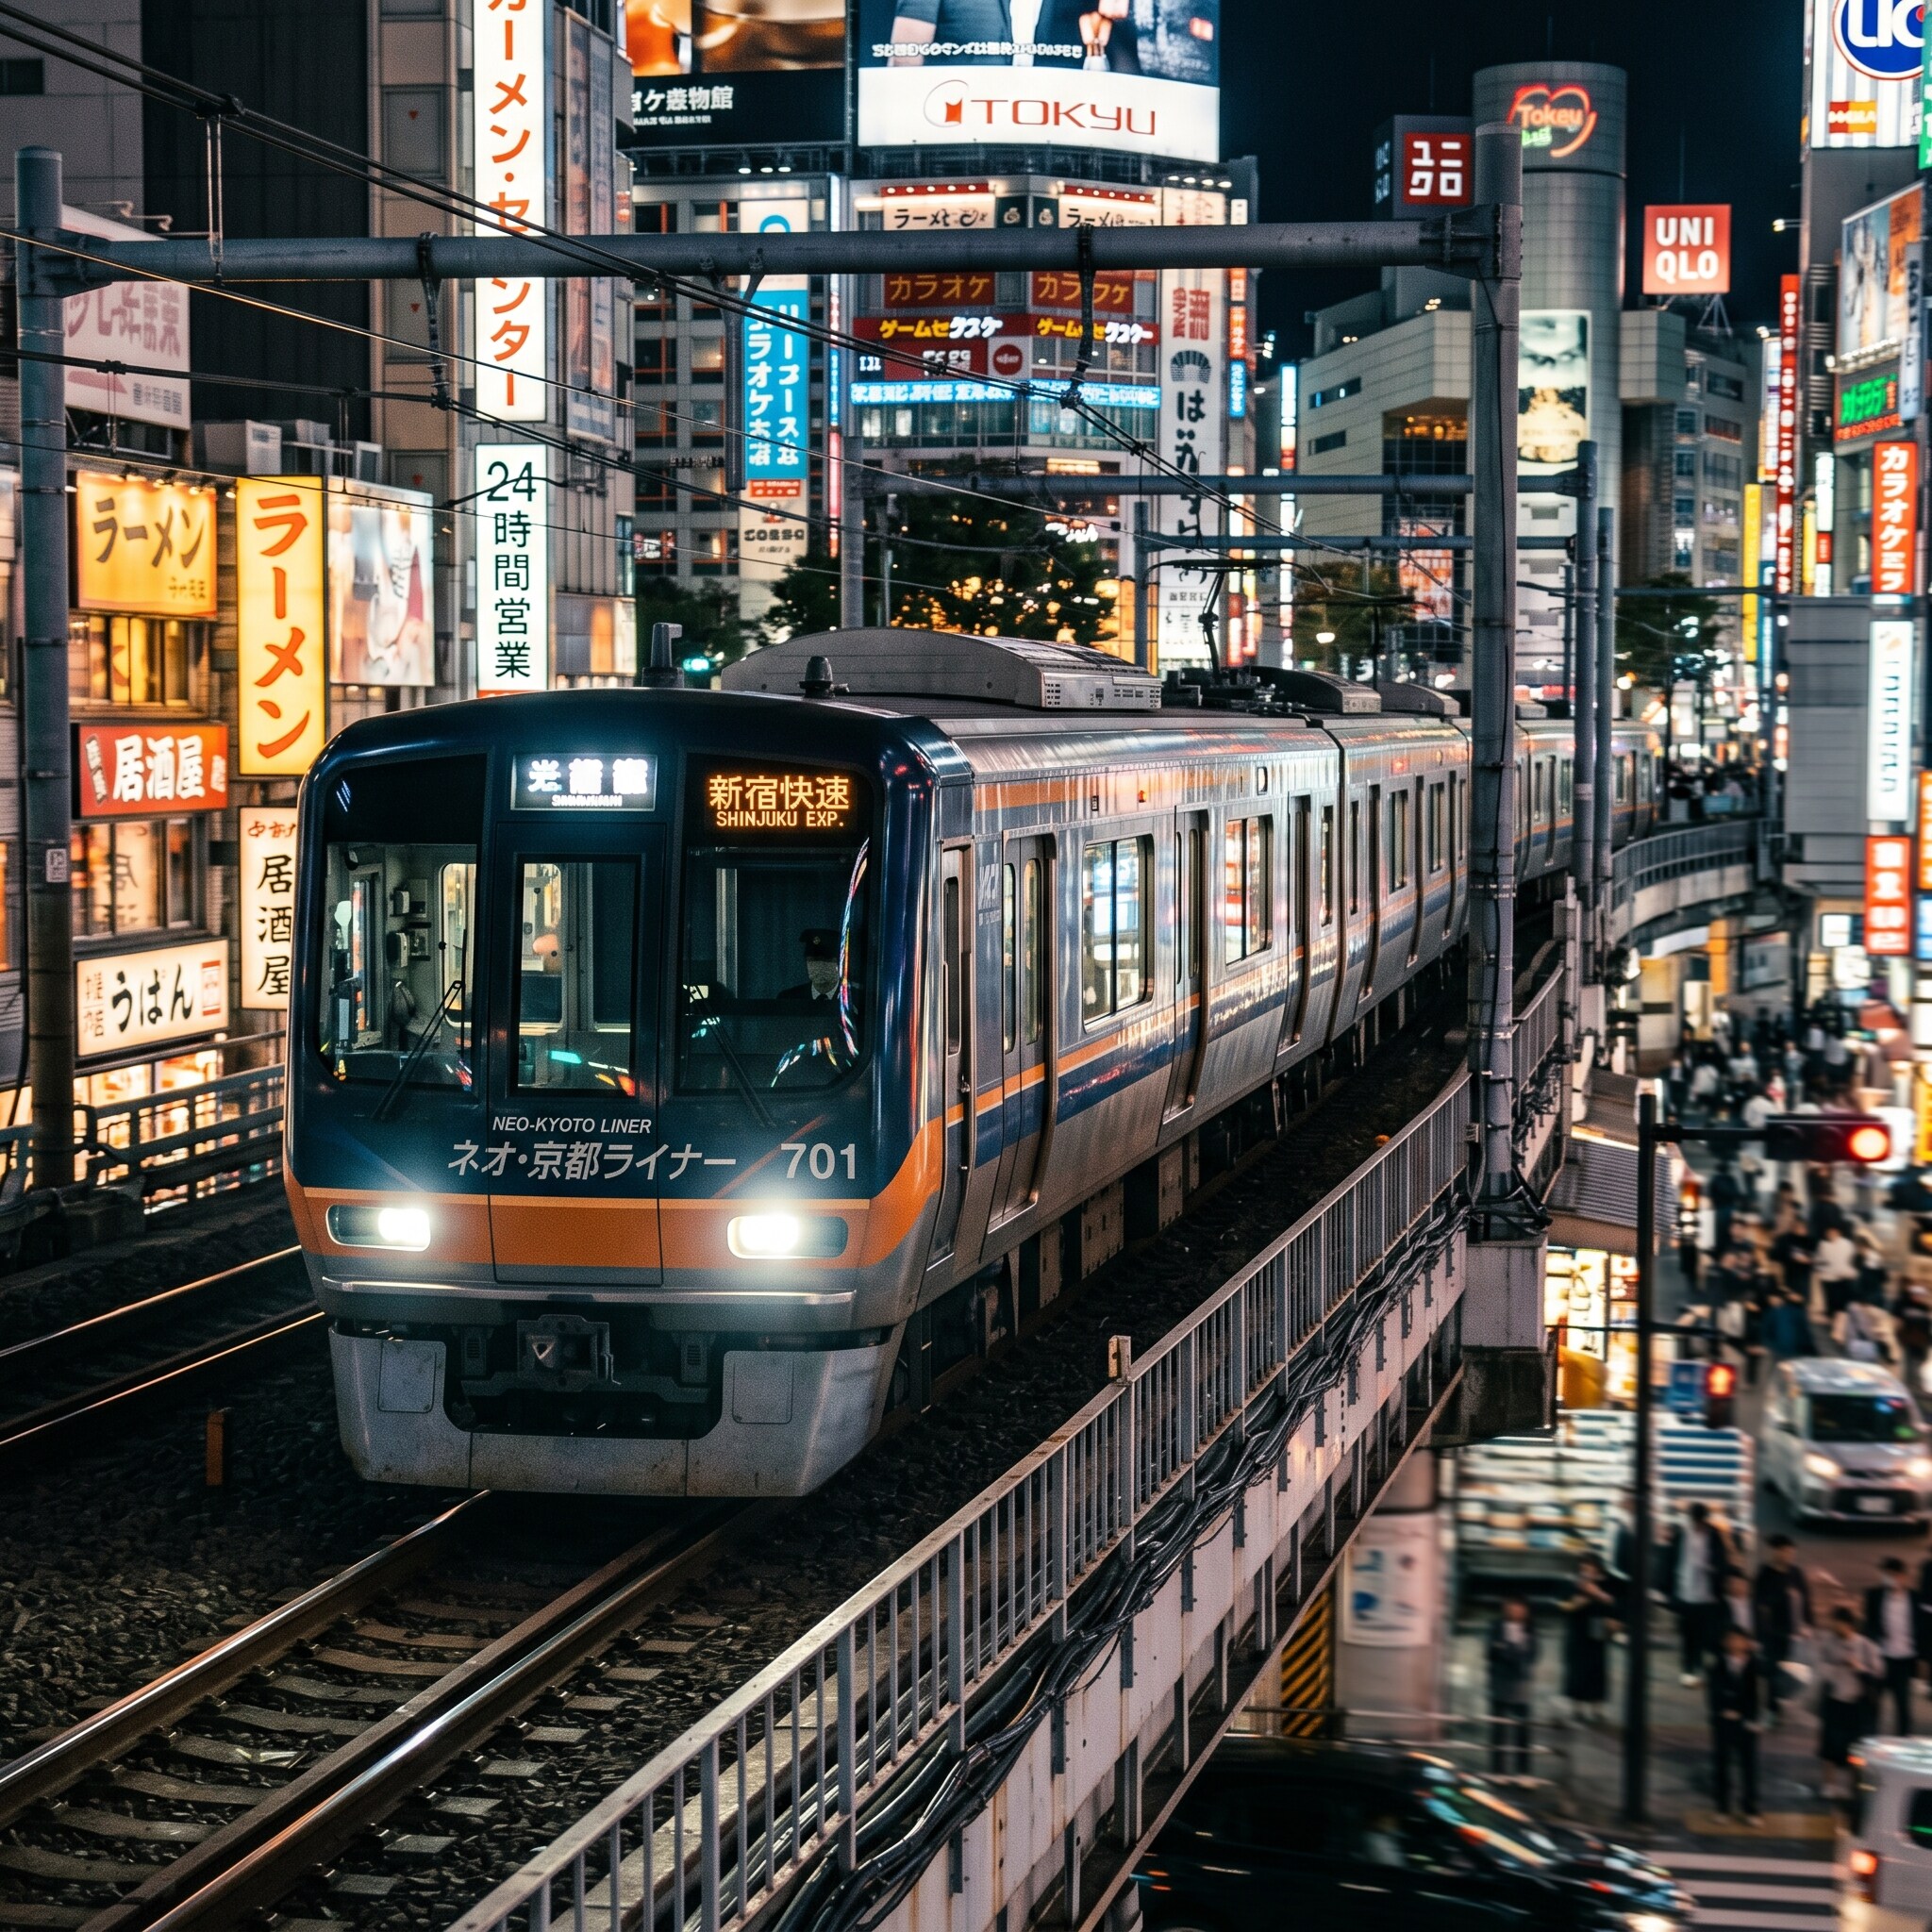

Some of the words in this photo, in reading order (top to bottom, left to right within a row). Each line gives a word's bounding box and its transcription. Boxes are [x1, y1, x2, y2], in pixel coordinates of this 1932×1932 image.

[970, 99, 1156, 136] TOKYU
[1656, 216, 1714, 246] UNI
[1655, 249, 1719, 285] QLO
[890, 275, 990, 301] カラオケ
[92, 497, 206, 569] ラーメン
[487, 460, 537, 678] 24時間営業
[253, 493, 310, 759] ラーメン
[112, 734, 206, 803] 居酒屋
[708, 774, 849, 809] 新宿快速
[716, 810, 797, 826] SHINJUKU
[806, 811, 844, 827] EXP.
[257, 854, 293, 996] 居酒屋
[491, 1116, 596, 1133] NEO-KYOTO
[601, 1117, 652, 1134] LINER
[447, 1139, 737, 1180] ネオ・京都ライナー
[780, 1142, 857, 1179] 701
